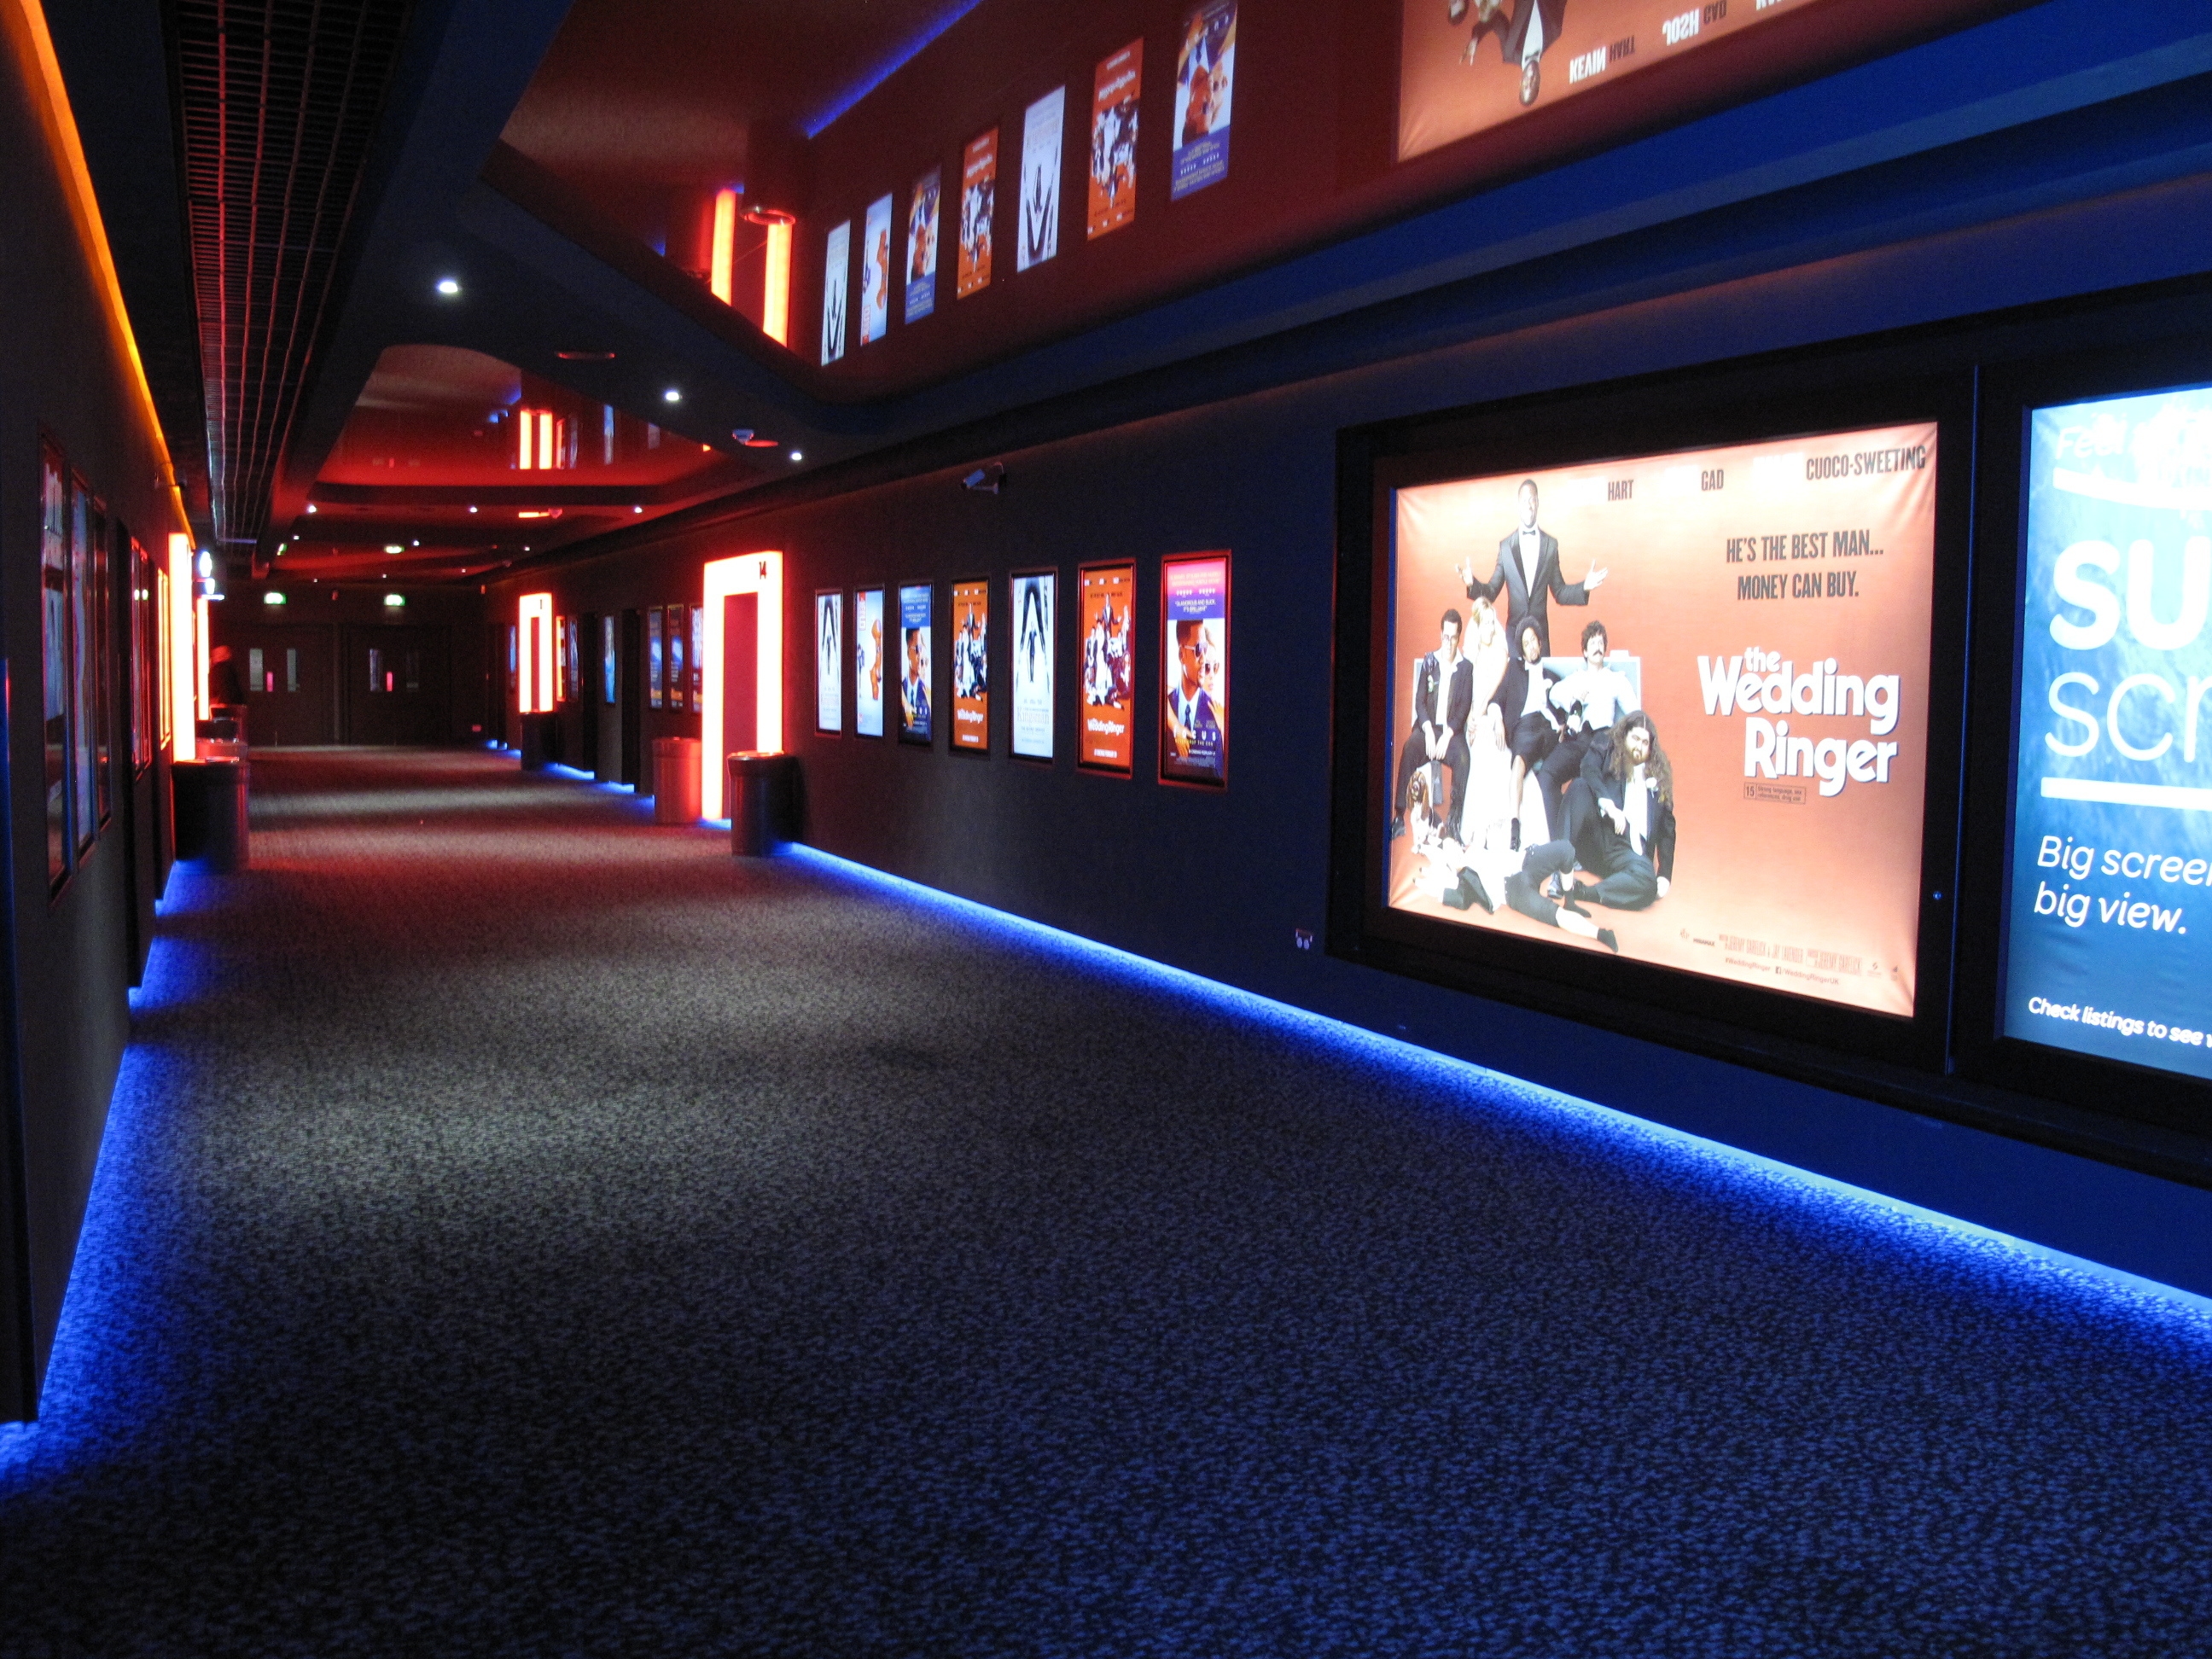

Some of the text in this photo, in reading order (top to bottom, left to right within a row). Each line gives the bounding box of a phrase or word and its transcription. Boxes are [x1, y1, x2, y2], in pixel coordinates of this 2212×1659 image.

[1806, 445, 1926, 480] CUOCO-SWEETING
[1607, 480, 1633, 501] HART
[1701, 469, 1724, 492] GAD
[1726, 529, 1883, 563] HE'S THE BEST MAN...
[759, 561, 767, 579] 14
[1738, 570, 1860, 600] MONEY CAN BUY.
[1744, 646, 1781, 672] the
[1697, 655, 1901, 736] Wedding
[1743, 716, 1899, 797] Ringer
[1746, 786, 1755, 796] 15
[2037, 835, 2094, 880] Big
[2033, 881, 2187, 934] big view.
[2028, 997, 2080, 1022] Check
[2082, 1006, 2145, 1035] listings
[2147, 1020, 2168, 1039] to
[2169, 1025, 2203, 1045] see
